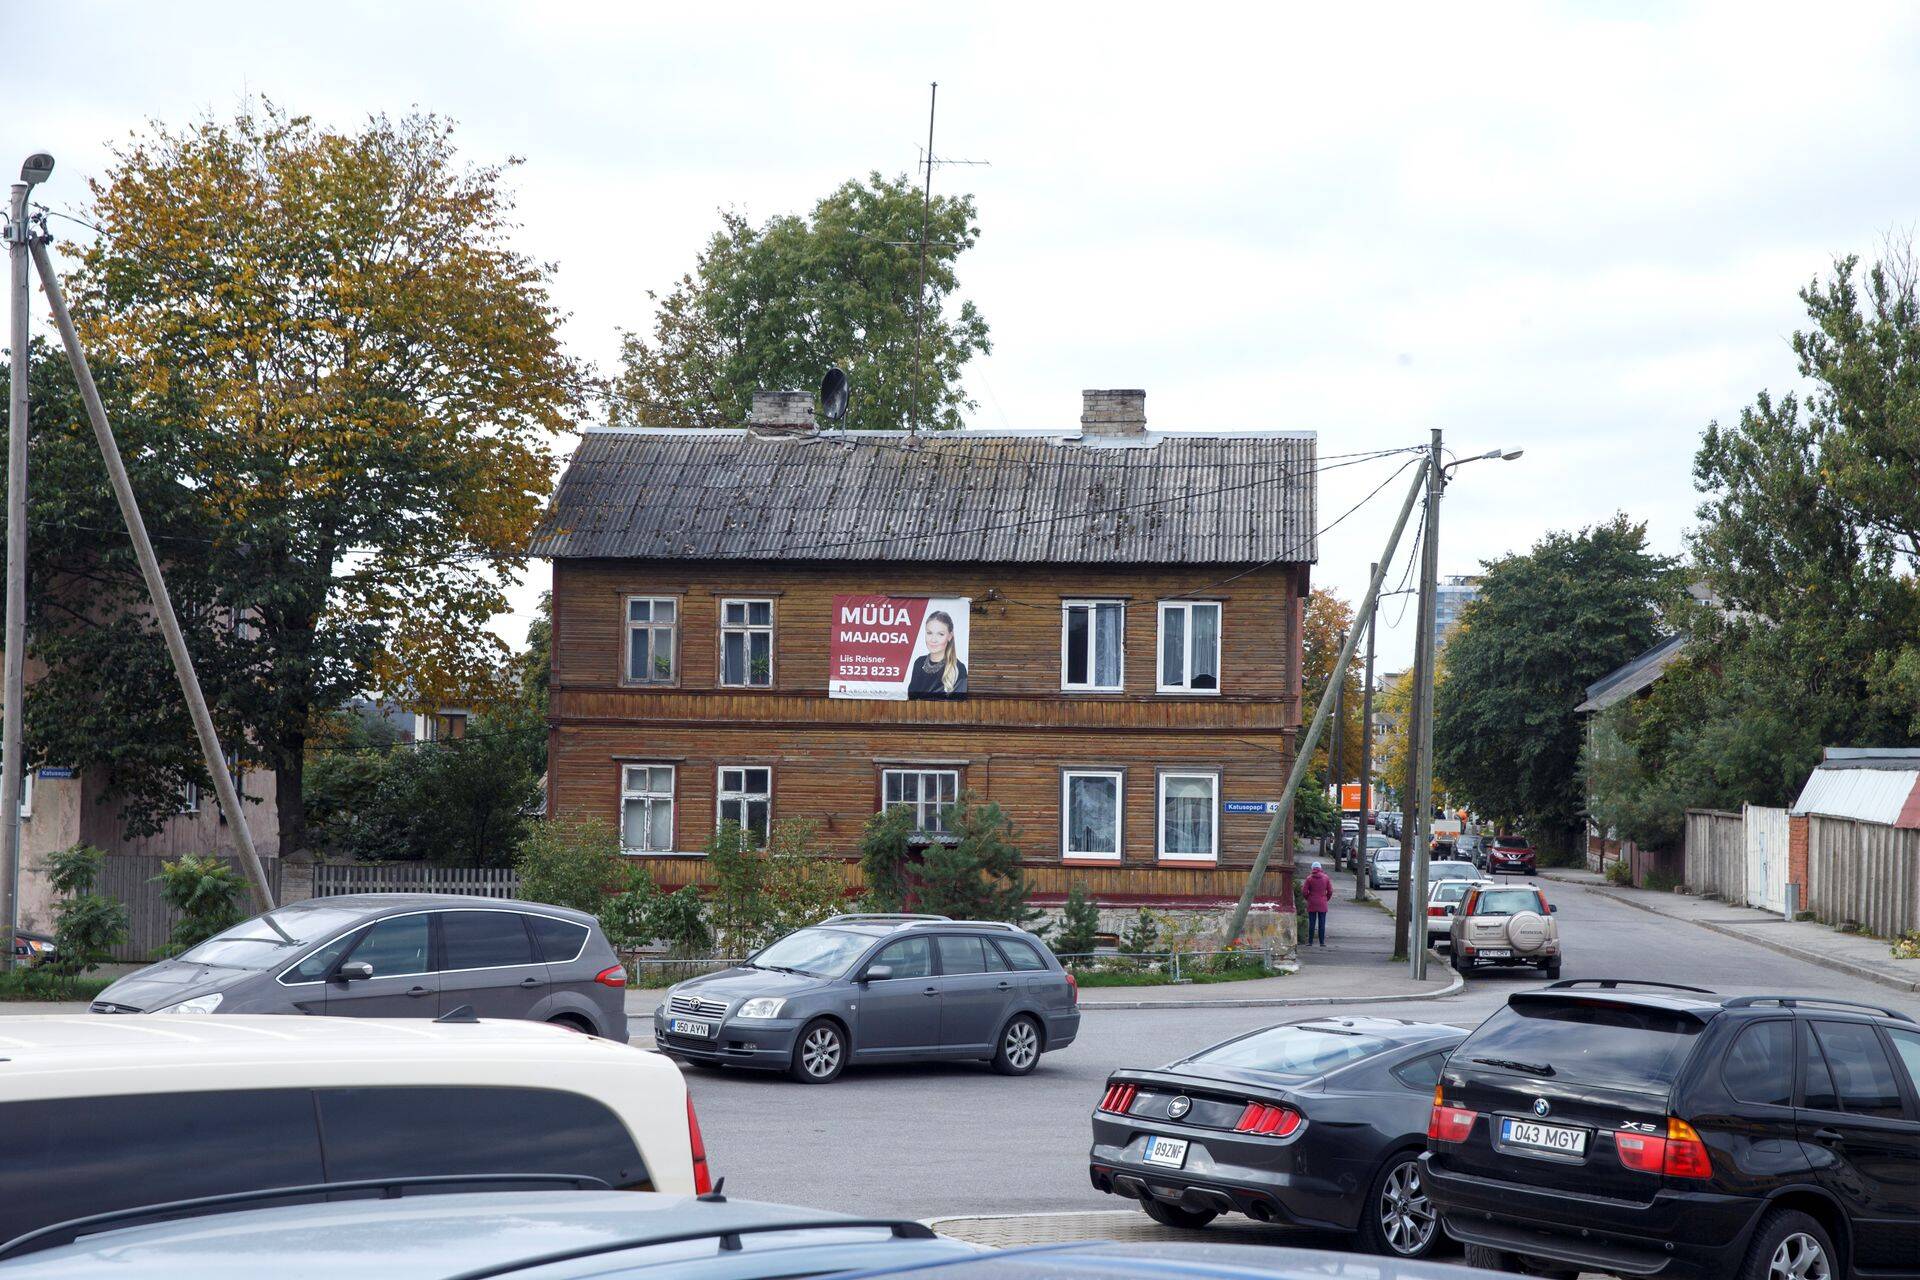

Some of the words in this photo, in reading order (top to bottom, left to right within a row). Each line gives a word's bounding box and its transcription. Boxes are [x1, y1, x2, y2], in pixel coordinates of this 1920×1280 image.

[841, 603, 912, 626] MÜÜA
[840, 631, 909, 644] MAJAOSA
[840, 654, 853, 663] Liis
[855, 655, 886, 663] Reisner
[839, 665, 868, 676] 5323
[871, 666, 900, 676] 8233
[690, 1024, 707, 1035] AYN
[1620, 1120, 1657, 1132] X5
[1515, 1124, 1540, 1143] 043
[1544, 1128, 1580, 1149] MGY
